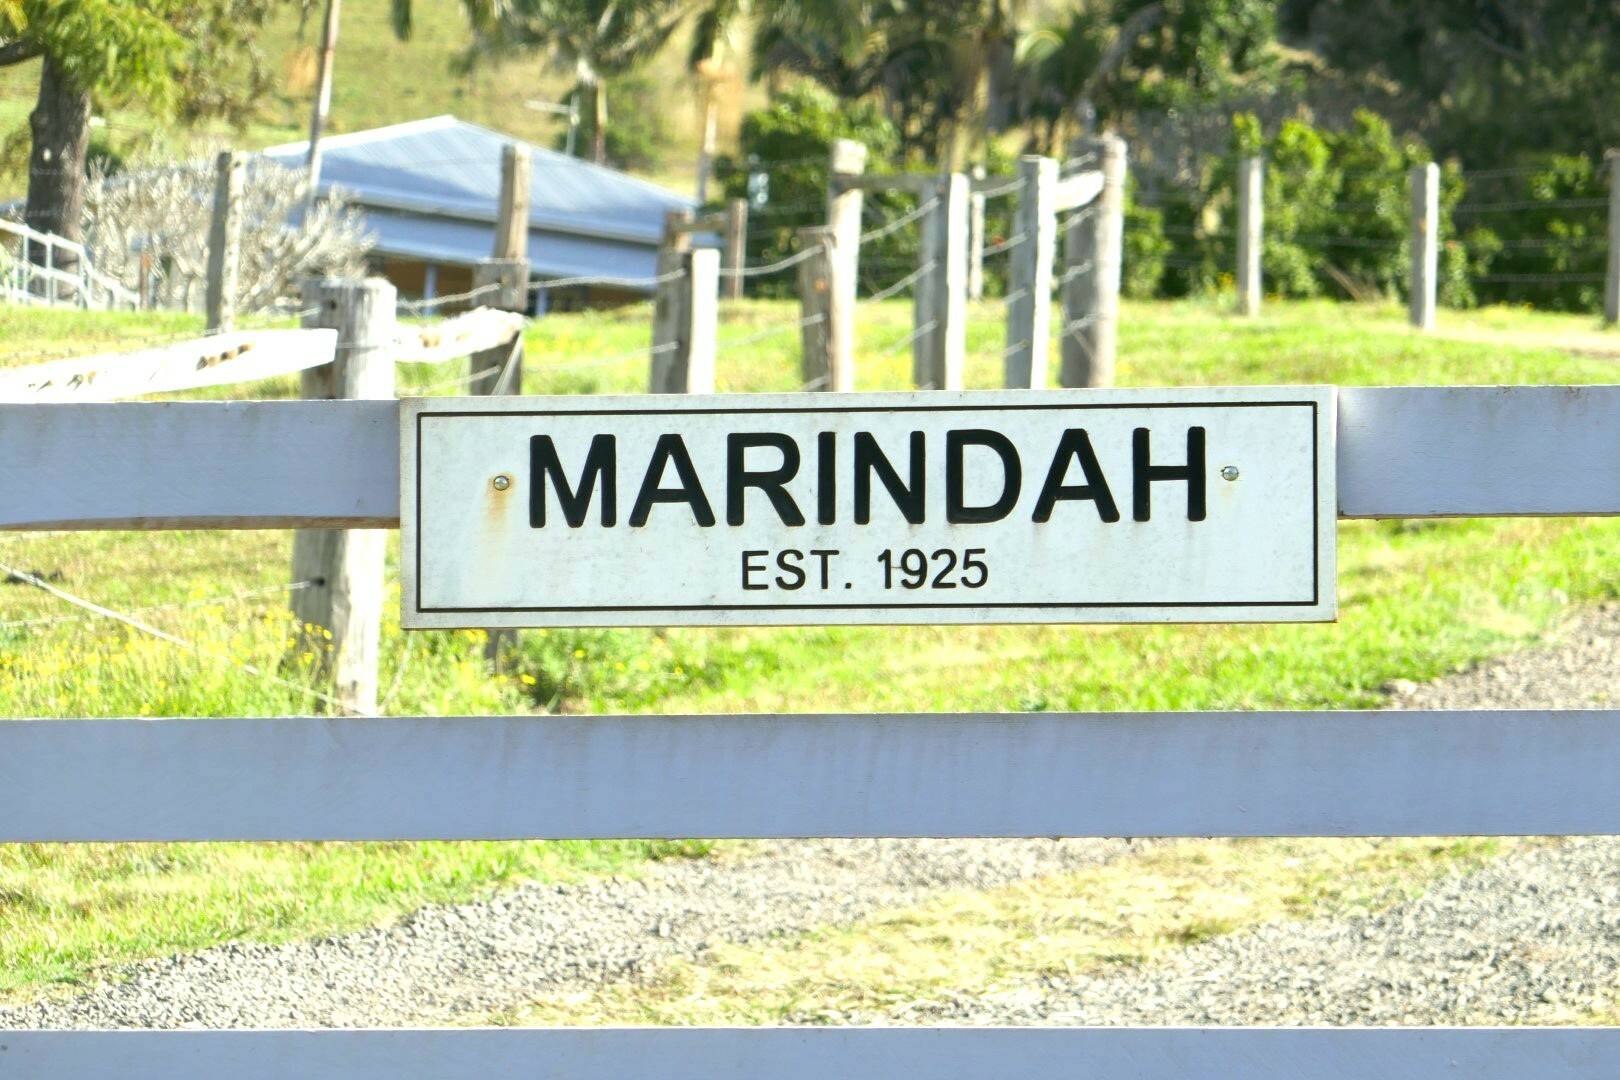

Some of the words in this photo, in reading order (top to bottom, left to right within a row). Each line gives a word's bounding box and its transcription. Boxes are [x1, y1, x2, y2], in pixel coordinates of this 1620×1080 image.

[529, 426, 1207, 529] MARINDAH
[741, 549, 852, 591] EST.
[877, 548, 989, 590] 1925
